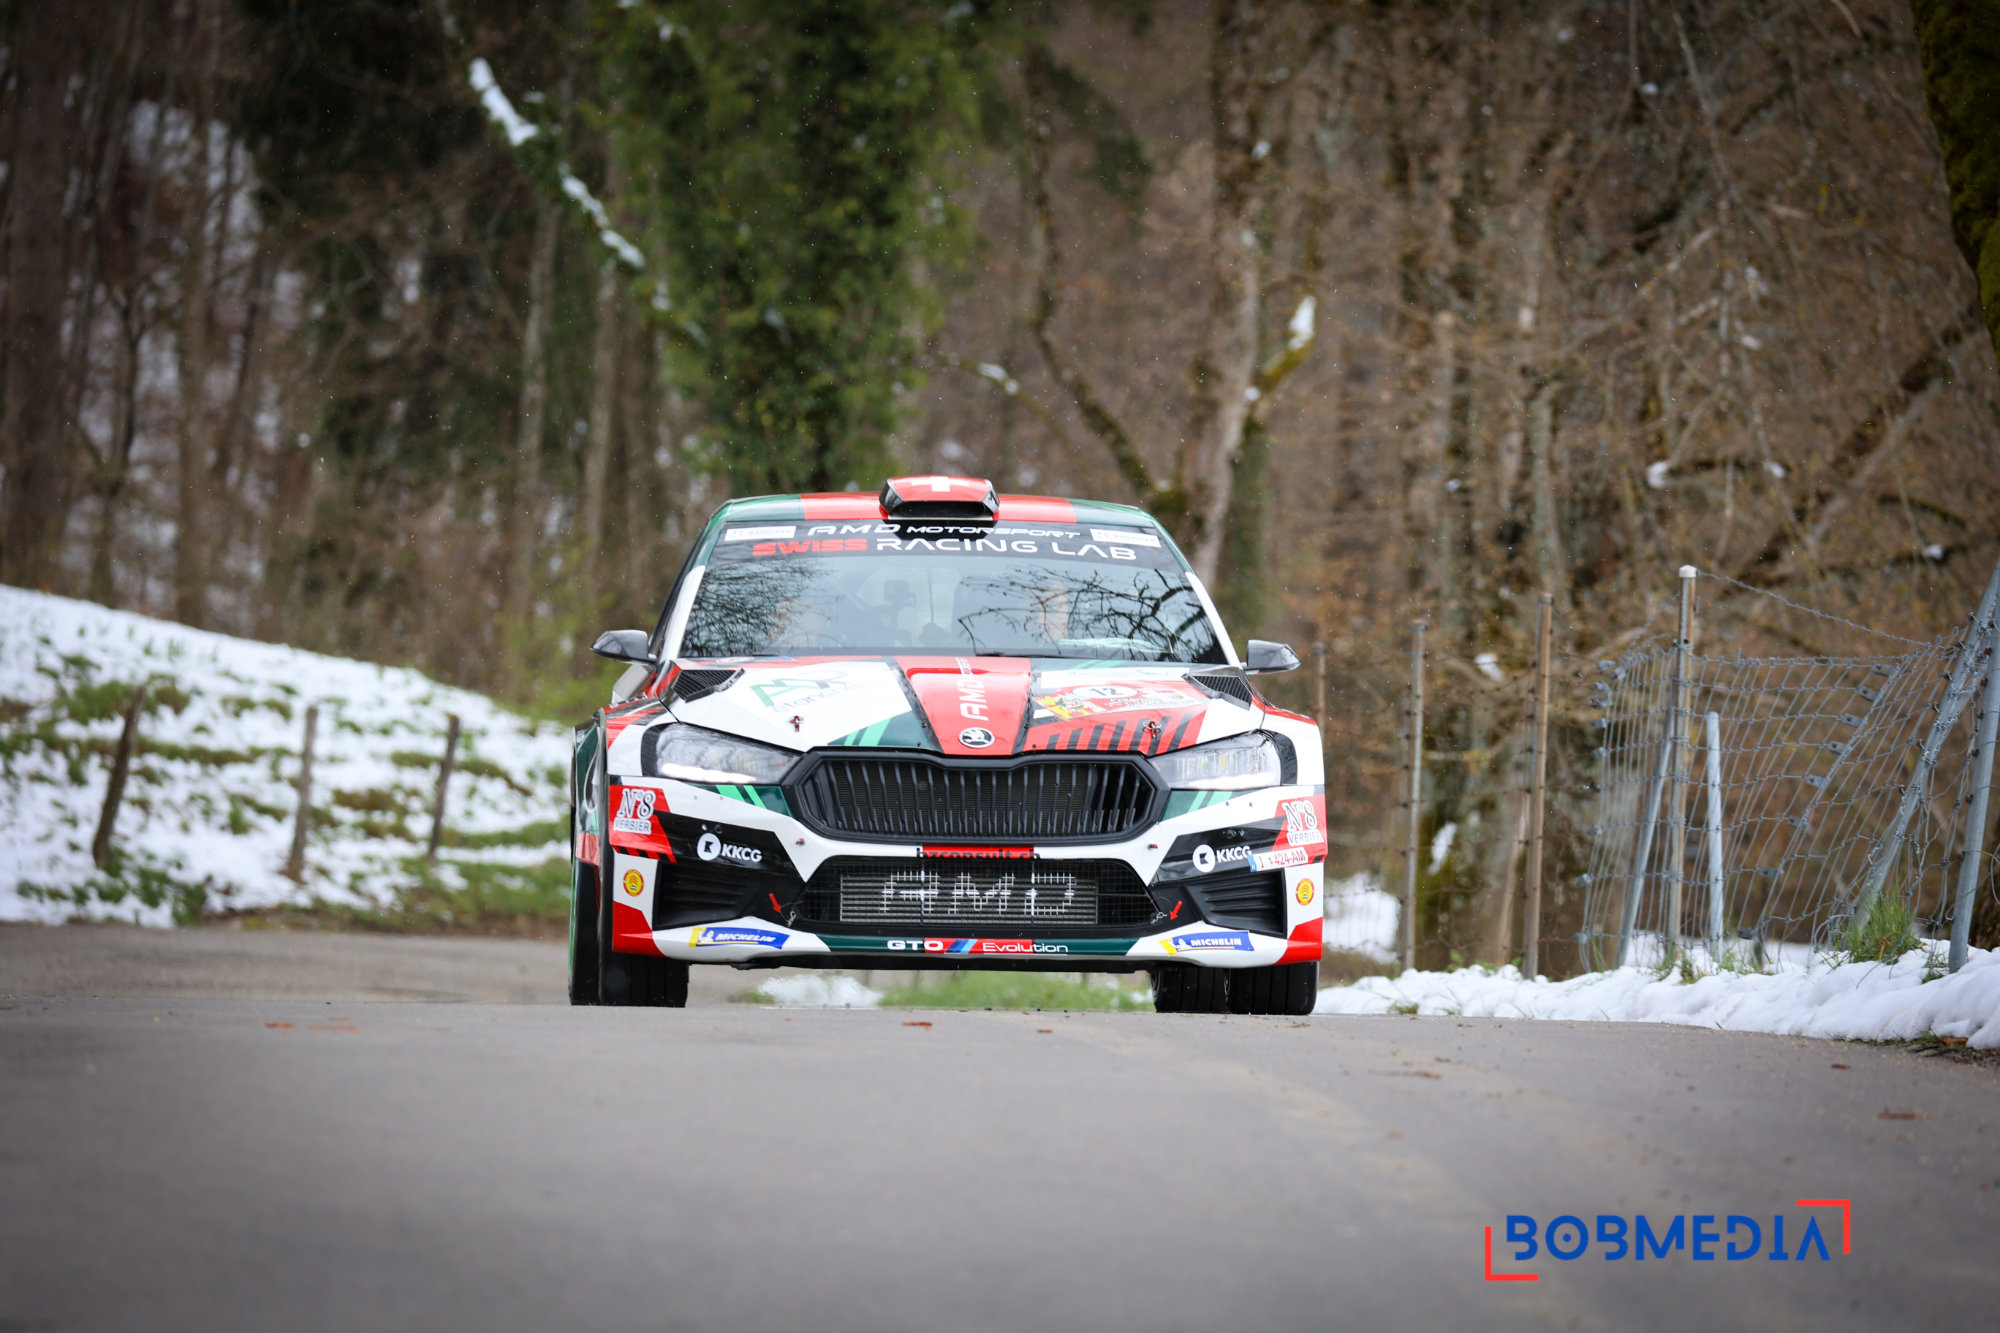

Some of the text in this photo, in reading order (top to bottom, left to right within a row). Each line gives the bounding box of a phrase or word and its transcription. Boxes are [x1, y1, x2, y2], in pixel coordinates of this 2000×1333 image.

[807, 524, 901, 537] AMD
[906, 525, 1081, 538] MOTORSPORT
[752, 538, 1137, 561] SWISS RACING LAB
[1089, 686, 1123, 697] 12
[614, 819, 652, 834] VERBIER
[1287, 830, 1323, 845] VERBIER
[721, 843, 763, 863] KKCG
[916, 847, 1042, 860] bzconsultch
[1216, 845, 1252, 863] KKCG
[879, 870, 1077, 916] AMD
[714, 933, 777, 943] MICHELIN
[1190, 937, 1243, 947] MICHELIN
[887, 939, 1069, 953] GTO Evolution
